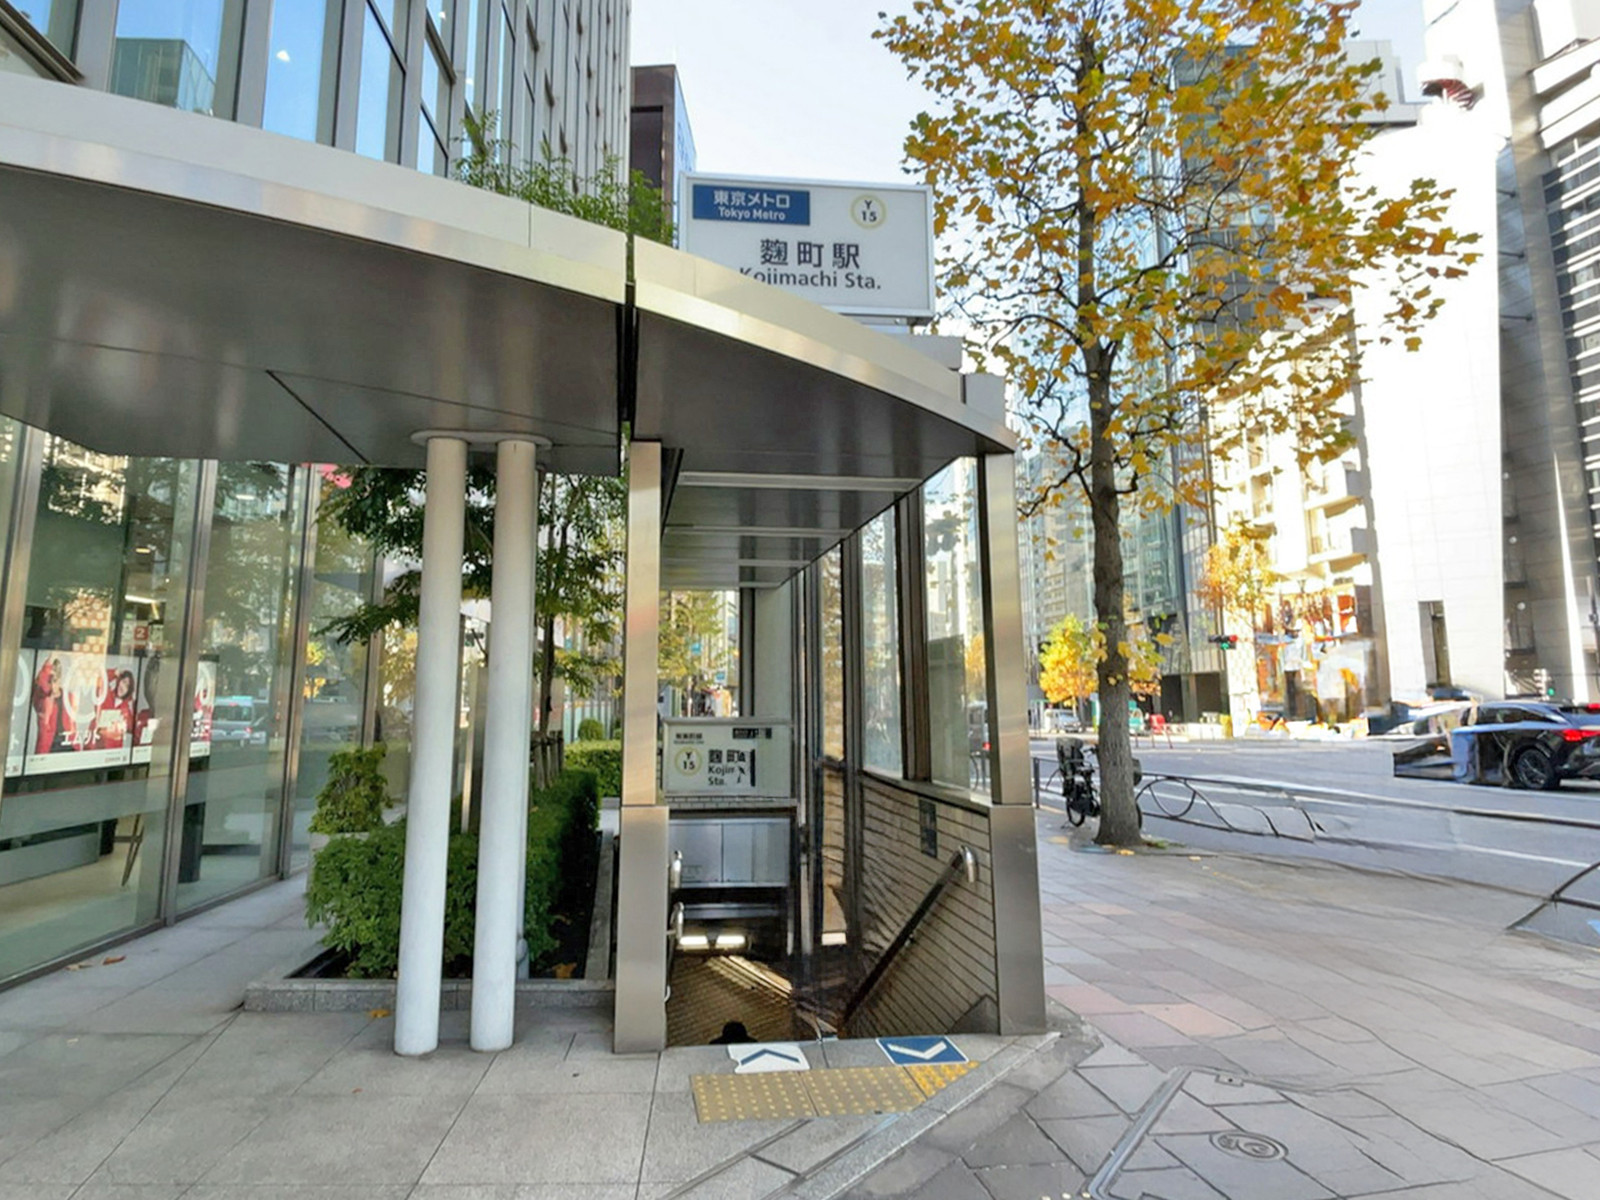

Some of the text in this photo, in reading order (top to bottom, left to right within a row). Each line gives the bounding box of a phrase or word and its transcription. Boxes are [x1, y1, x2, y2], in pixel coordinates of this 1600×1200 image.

[713, 190, 790, 209] 東京メトロ
[864, 199, 873, 210] Y
[719, 206, 786, 221] Tokyo Metro
[862, 210, 877, 223] 15
[845, 272, 881, 290] Sta.
[136, 627, 146, 639] 2
[685, 751, 692, 760] Y
[683, 760, 696, 770] 15
